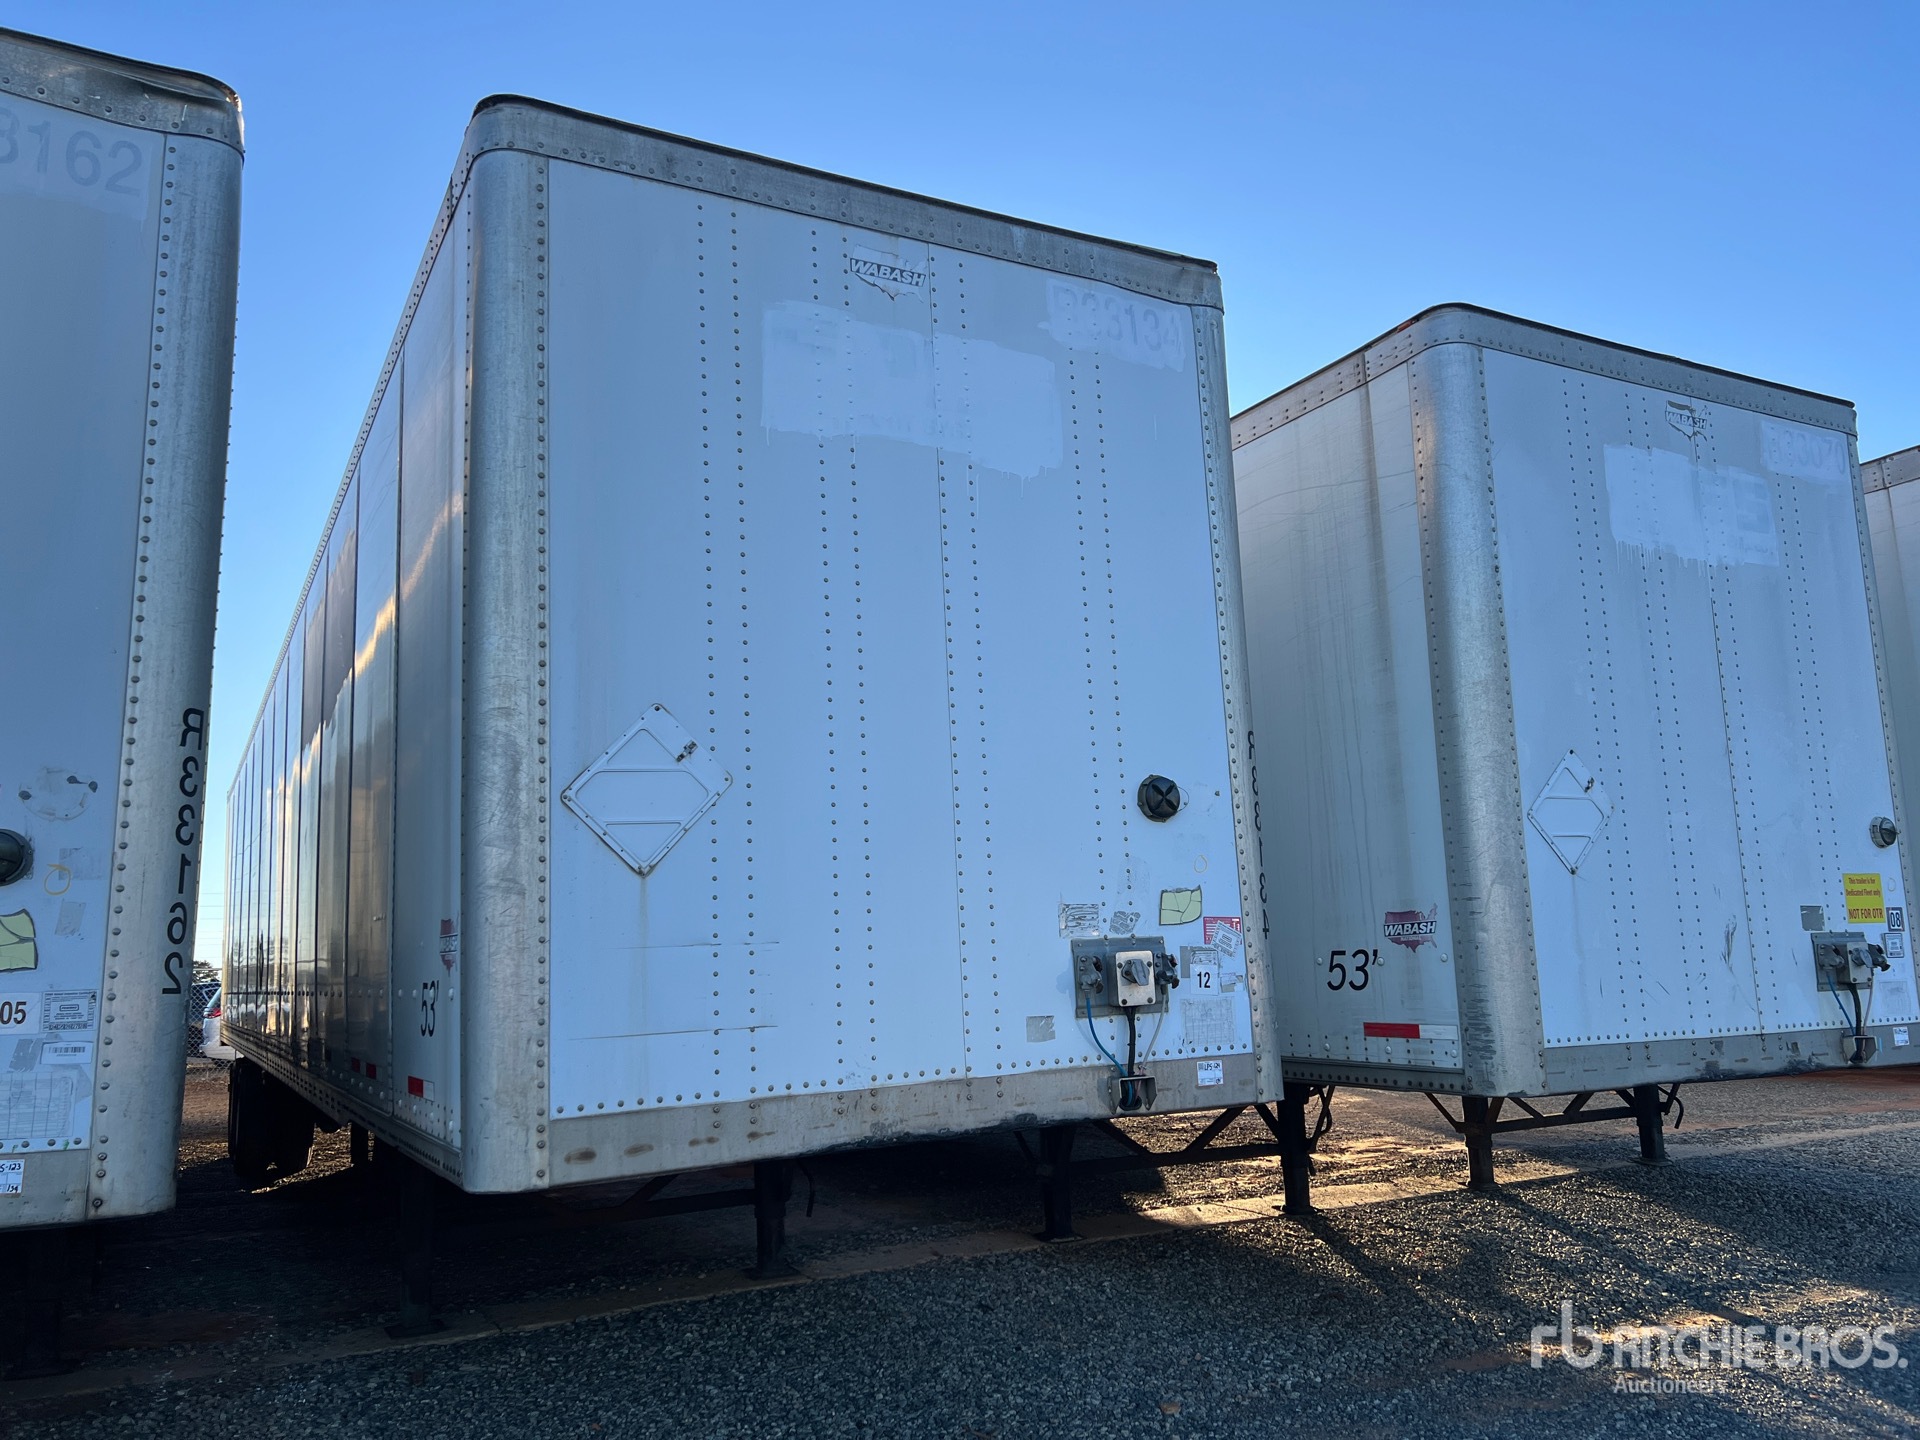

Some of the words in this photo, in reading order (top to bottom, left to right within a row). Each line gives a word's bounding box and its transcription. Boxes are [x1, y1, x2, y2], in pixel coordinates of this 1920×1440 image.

[850, 258, 926, 287] WABASH
[1665, 411, 1707, 429] WABASH
[1873, 889, 1881, 898] only
[1848, 908, 1860, 919] NOT
[1861, 908, 1872, 919] FOR
[1872, 908, 1883, 918] OTR
[1890, 912, 1901, 928] 08
[1385, 921, 1436, 936] WABASH
[1327, 948, 1378, 991] 53'
[1197, 971, 1211, 989] 12
[0, 1001, 27, 1025] 05
